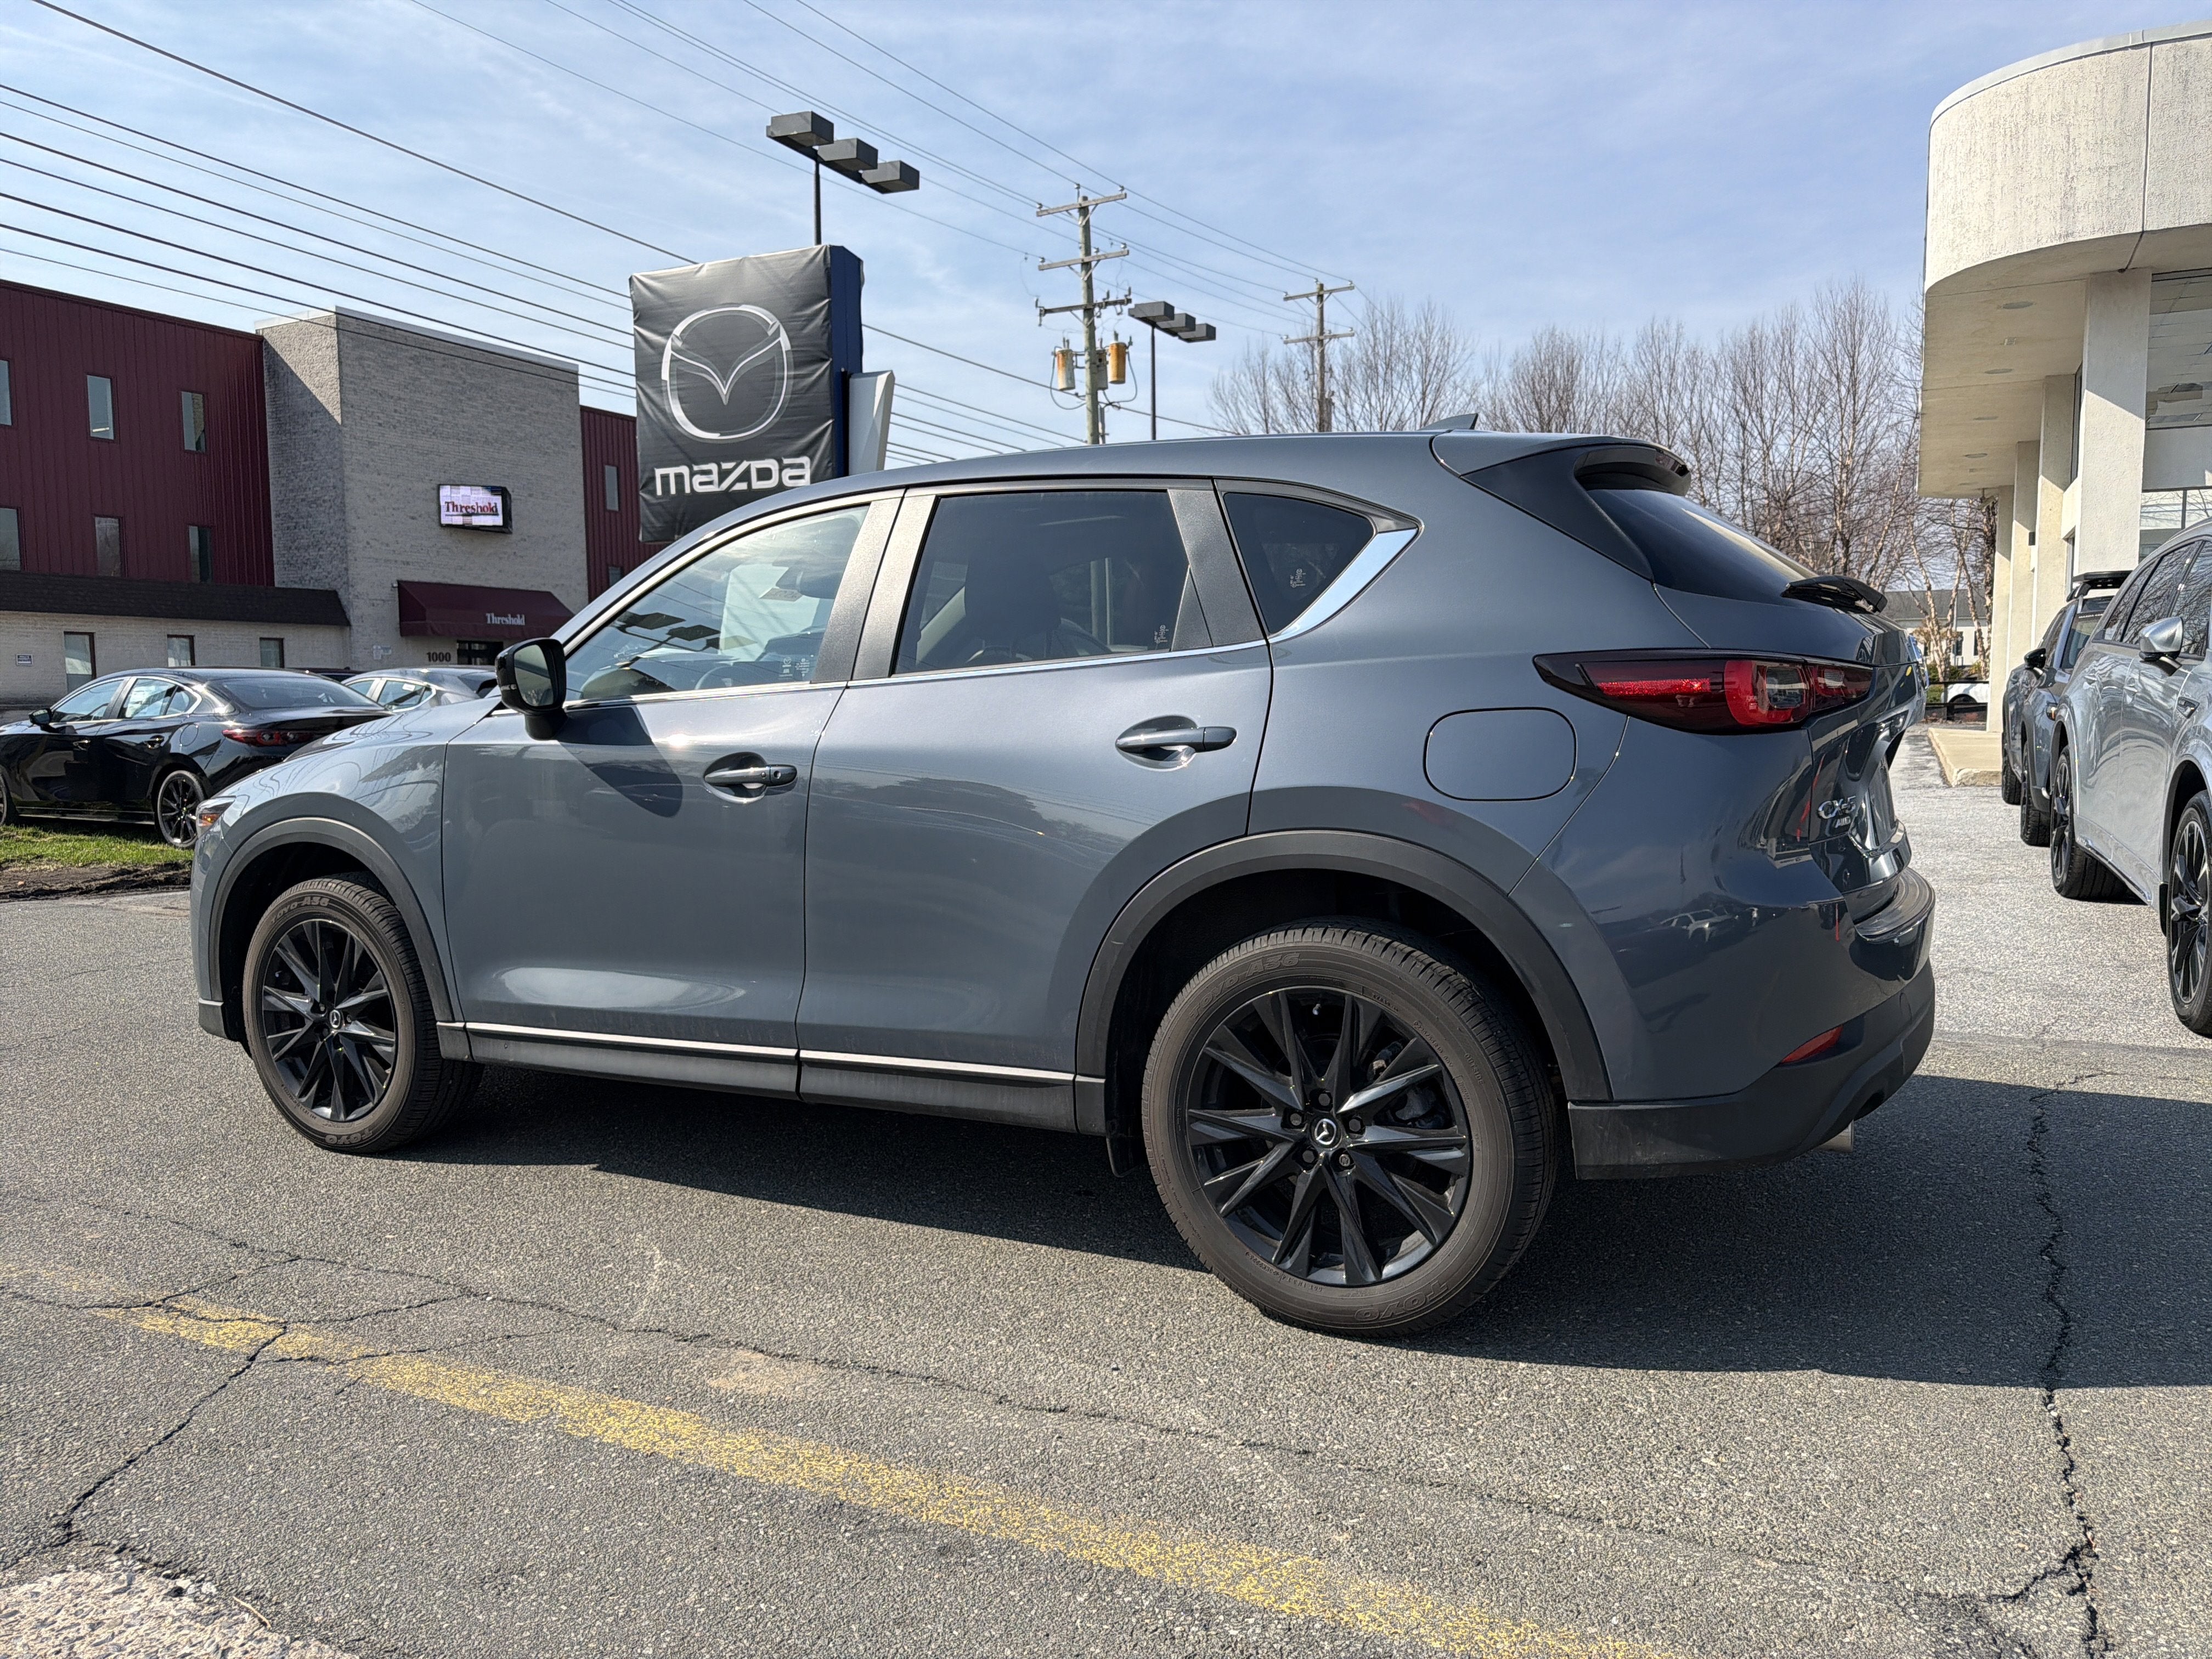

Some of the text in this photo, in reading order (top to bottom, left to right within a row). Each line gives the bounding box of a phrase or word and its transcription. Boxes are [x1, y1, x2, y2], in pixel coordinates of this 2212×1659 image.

[444, 501, 498, 514] Threshold
[486, 612, 526, 625] Threshold
[426, 651, 452, 663] 1000
[1818, 795, 1856, 819] CX-5
[300, 896, 330, 907] A36
[1189, 953, 1300, 1020] TOYO A36
[325, 1128, 374, 1145] TOYO
[1355, 1280, 1449, 1321] TOYO
